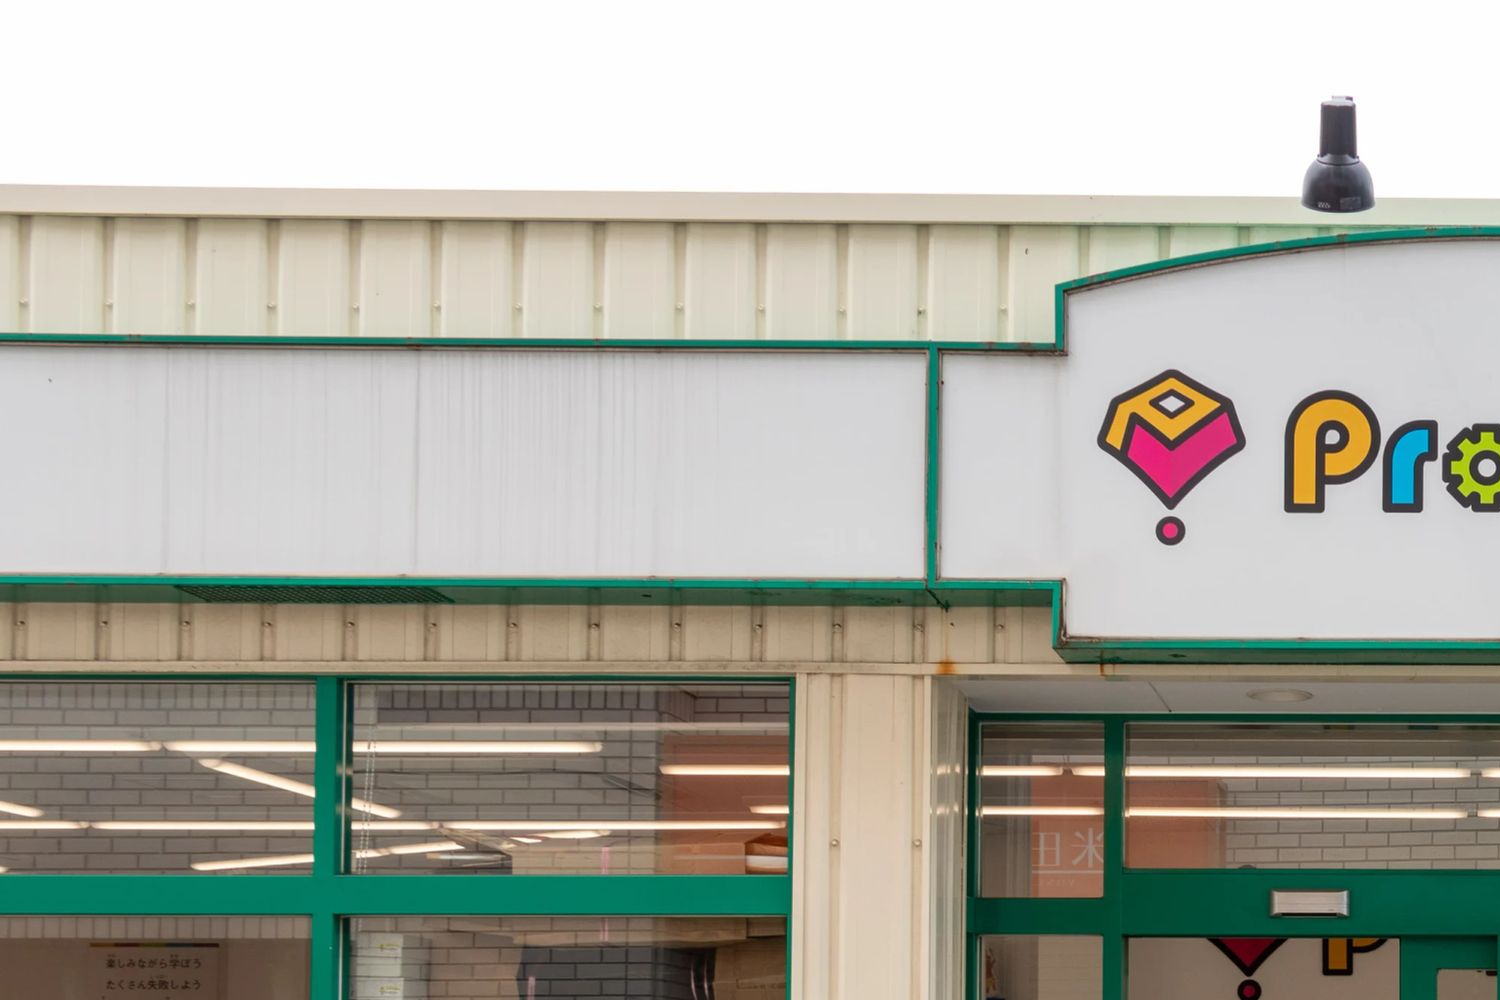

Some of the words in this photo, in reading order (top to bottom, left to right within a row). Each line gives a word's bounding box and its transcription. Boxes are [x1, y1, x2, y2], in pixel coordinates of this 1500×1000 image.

[106, 979, 202, 990] たくさん失敗しよう
